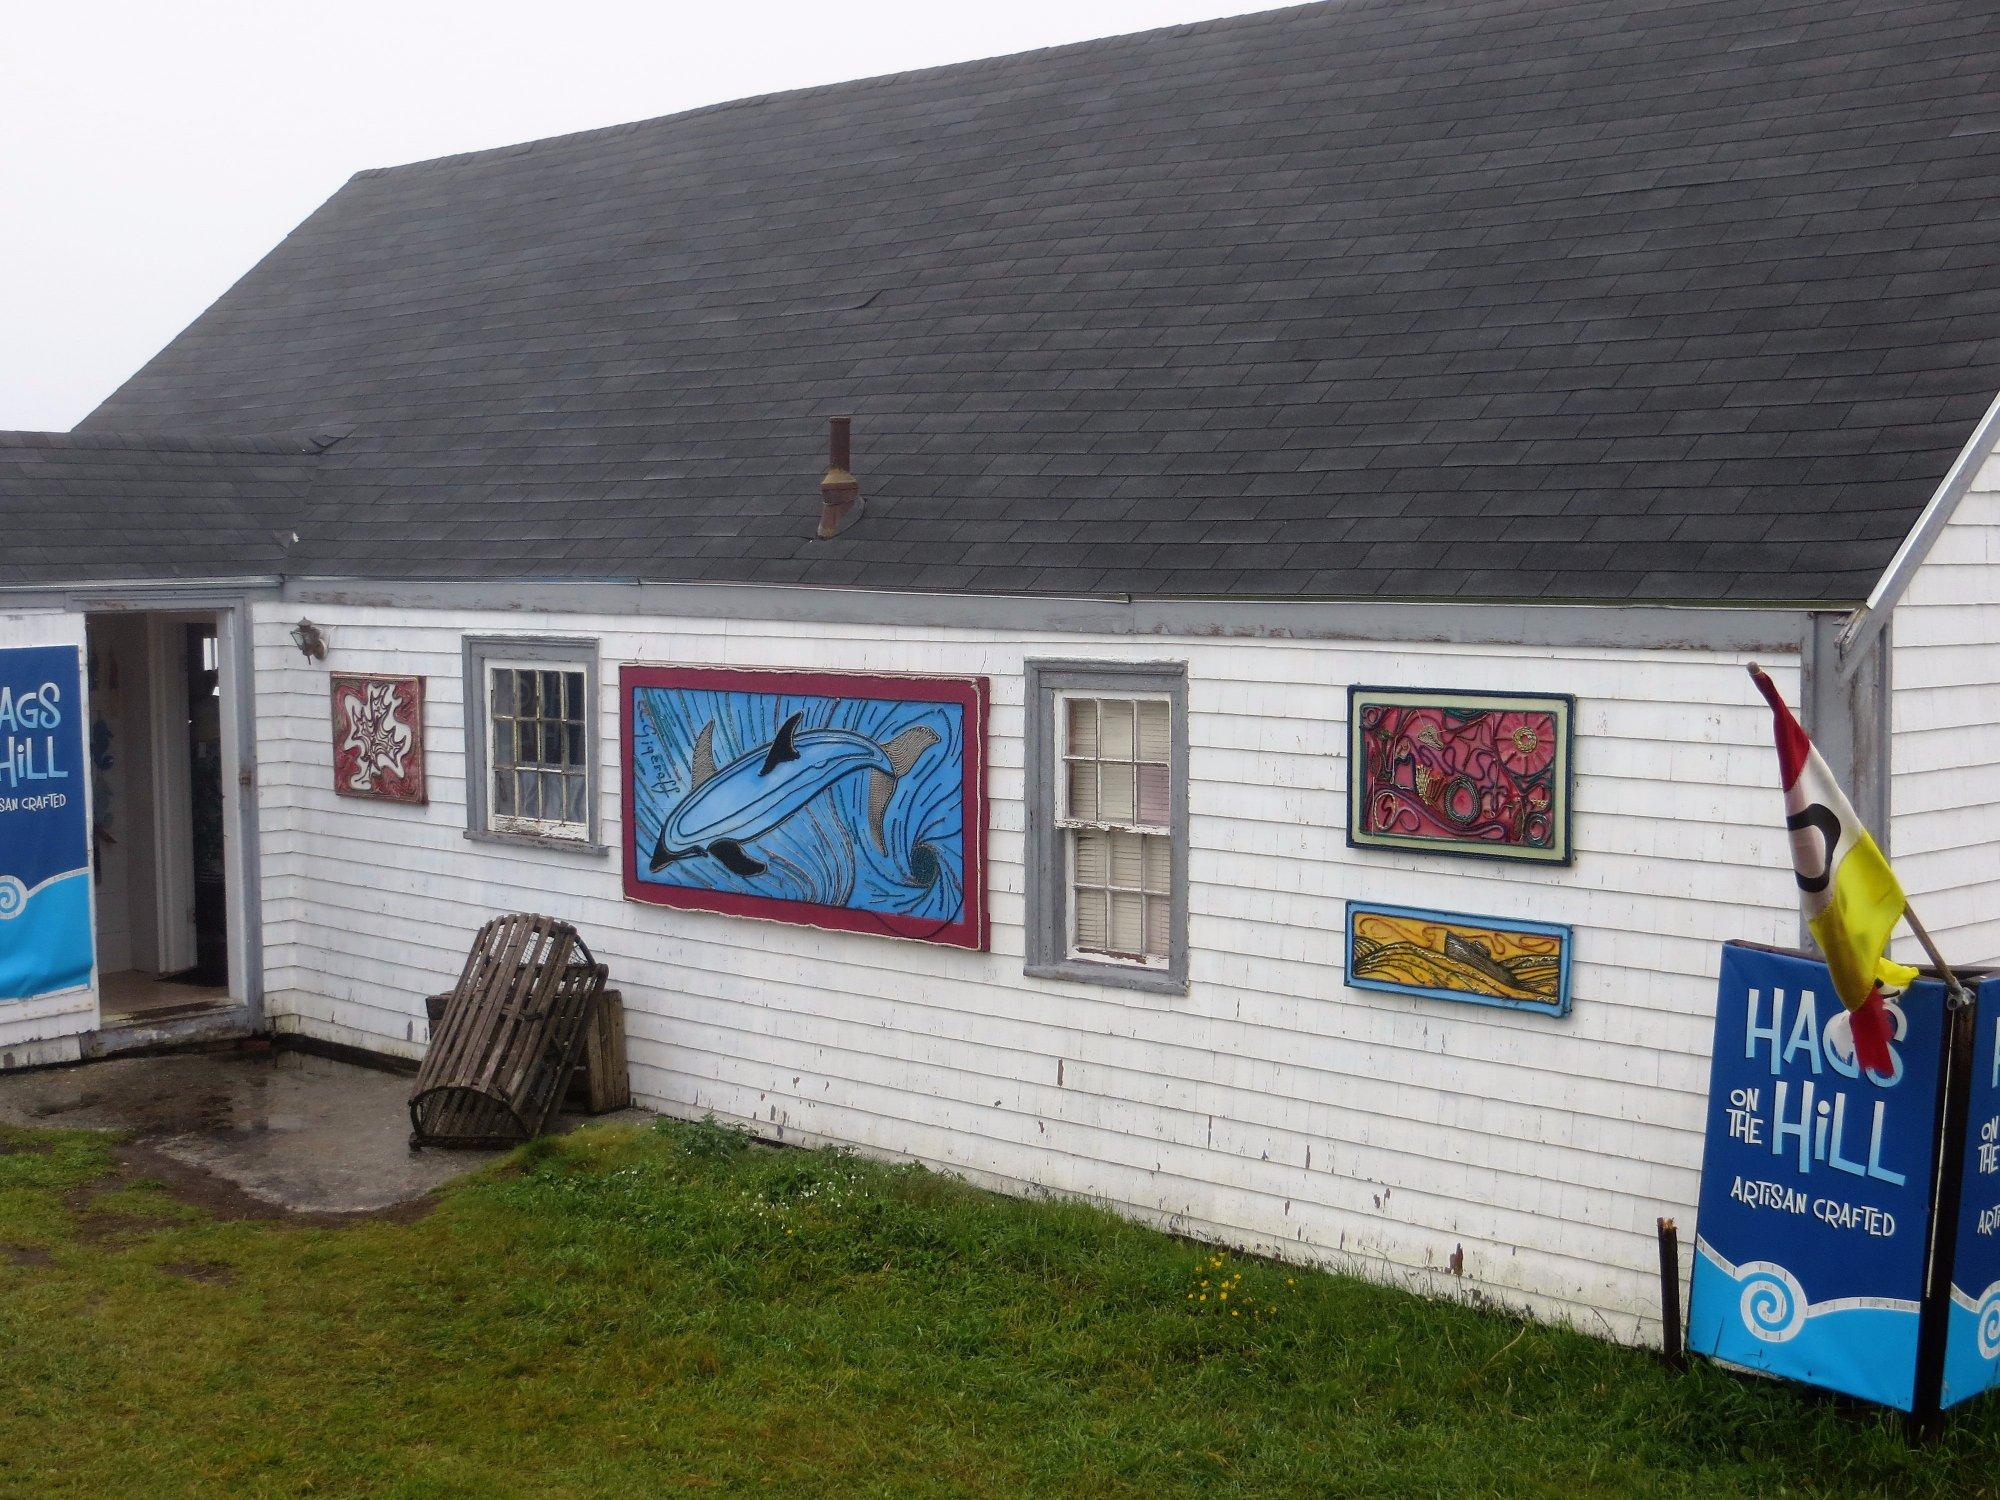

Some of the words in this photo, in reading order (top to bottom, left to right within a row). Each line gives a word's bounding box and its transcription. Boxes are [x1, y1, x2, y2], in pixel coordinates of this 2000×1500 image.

[0, 682, 61, 732] AGS
[22, 793, 67, 812] CRAFTED
[1730, 1088, 1760, 1112] ON
[1726, 1108, 1765, 1145] THE
[1771, 1080, 1906, 1187] HiLL
[1981, 1115, 2000, 1142] ON
[1978, 1142, 2000, 1175] THE
[1730, 1175, 1808, 1215] ARTiSAN
[1813, 1198, 1897, 1238] CRAFTED
